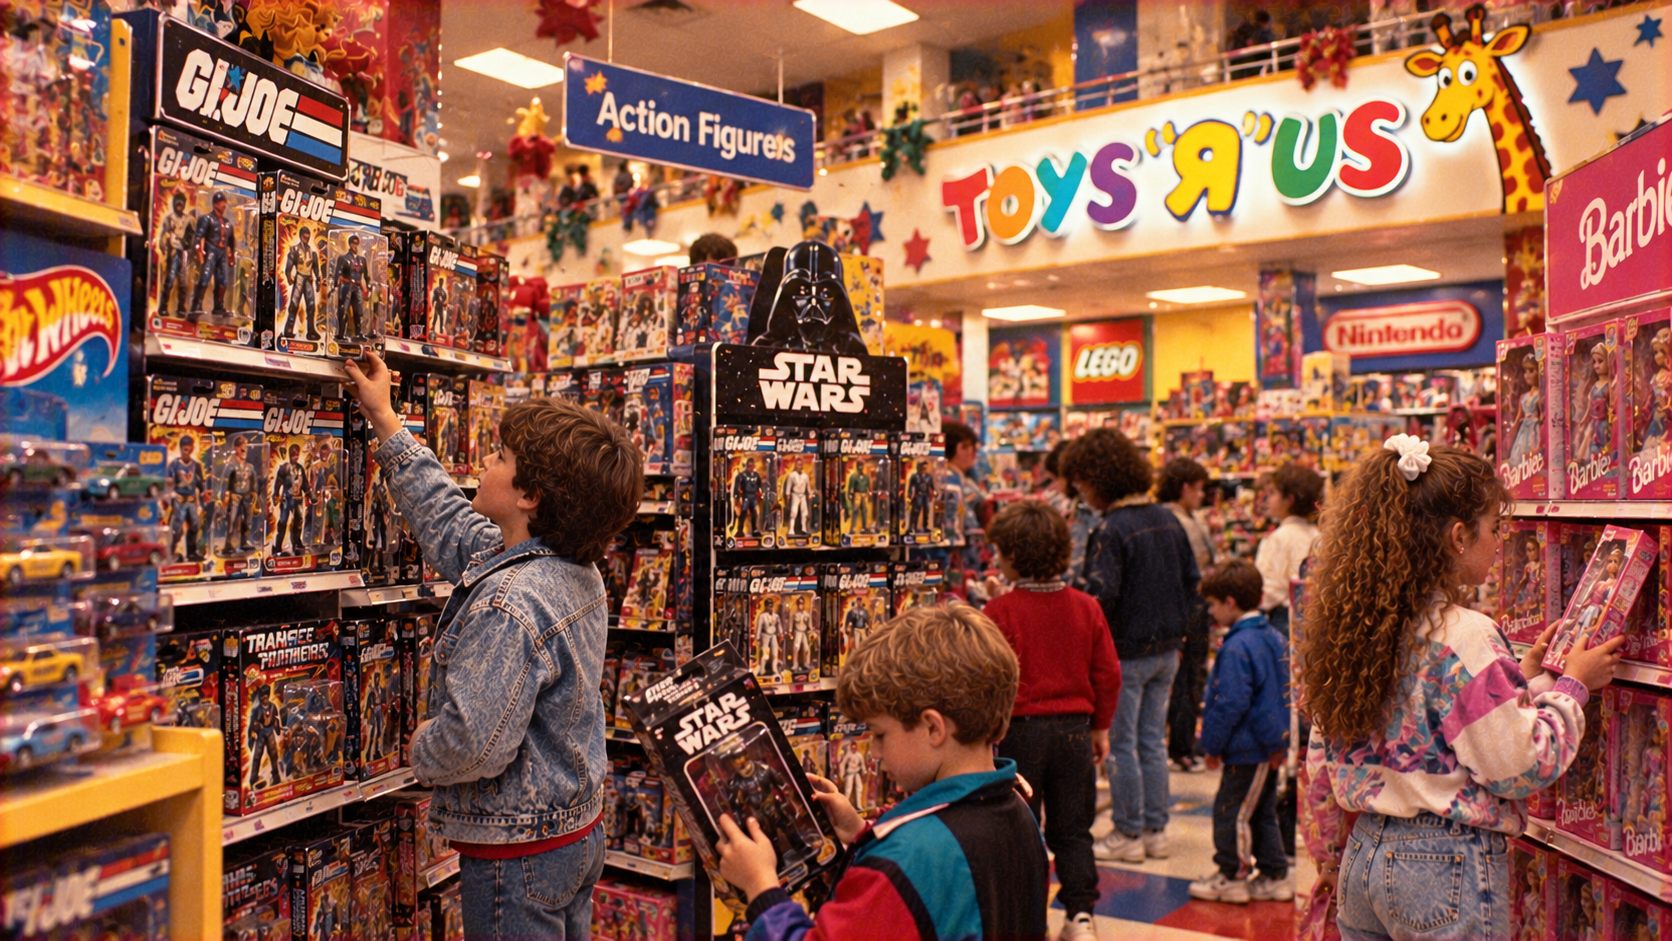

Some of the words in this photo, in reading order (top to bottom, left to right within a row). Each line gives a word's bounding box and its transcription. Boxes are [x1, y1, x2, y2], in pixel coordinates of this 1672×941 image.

[596, 91, 690, 142] Action
[941, 142, 1138, 247] TOYS
[1271, 100, 1404, 199] US
[1337, 317, 1463, 346] Nintendo
[758, 352, 871, 386] STAR
[1074, 345, 1139, 379] LEGO
[758, 380, 871, 414] WARS
[1628, 445, 1672, 494] Barbi
[674, 691, 749, 743] STAR
[676, 701, 751, 756] WARS
